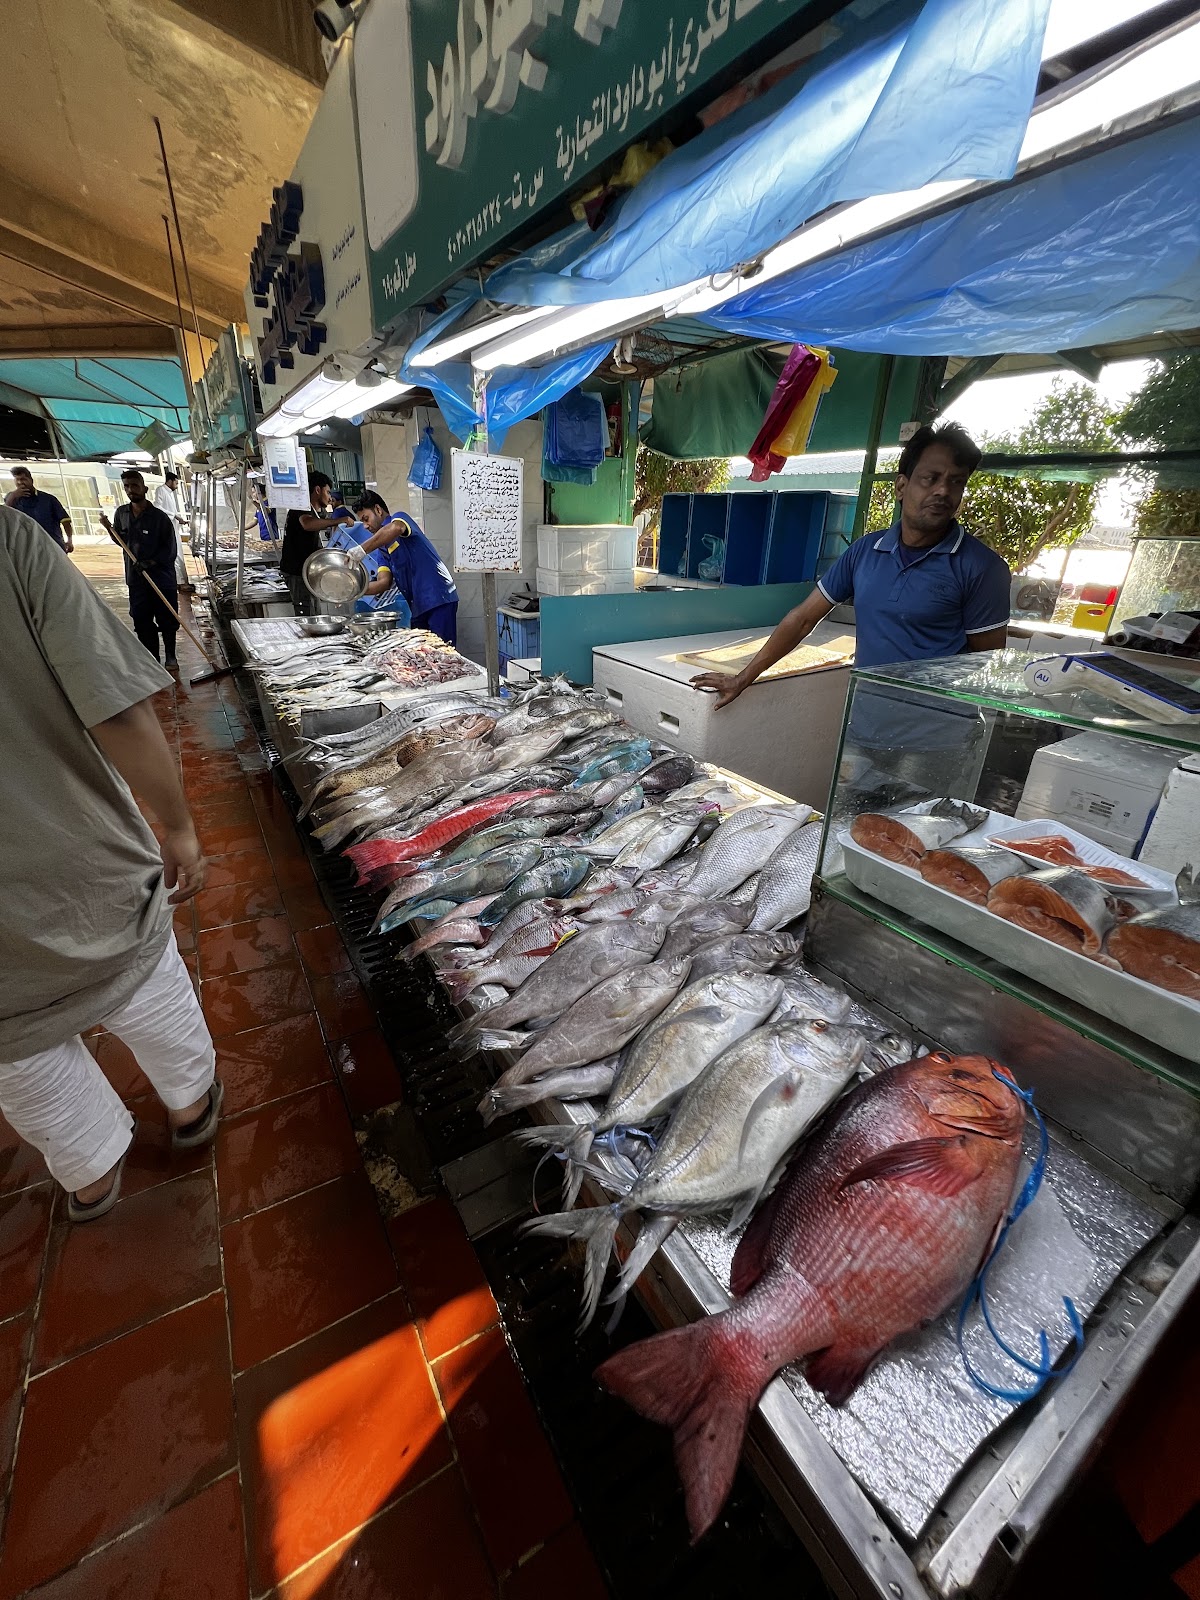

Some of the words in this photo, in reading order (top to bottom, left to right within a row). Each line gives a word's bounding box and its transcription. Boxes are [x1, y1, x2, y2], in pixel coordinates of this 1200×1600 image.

[612, 64, 644, 132] داود
[556, 87, 611, 181] التجارية
[1036, 673, 1050, 683] AU
